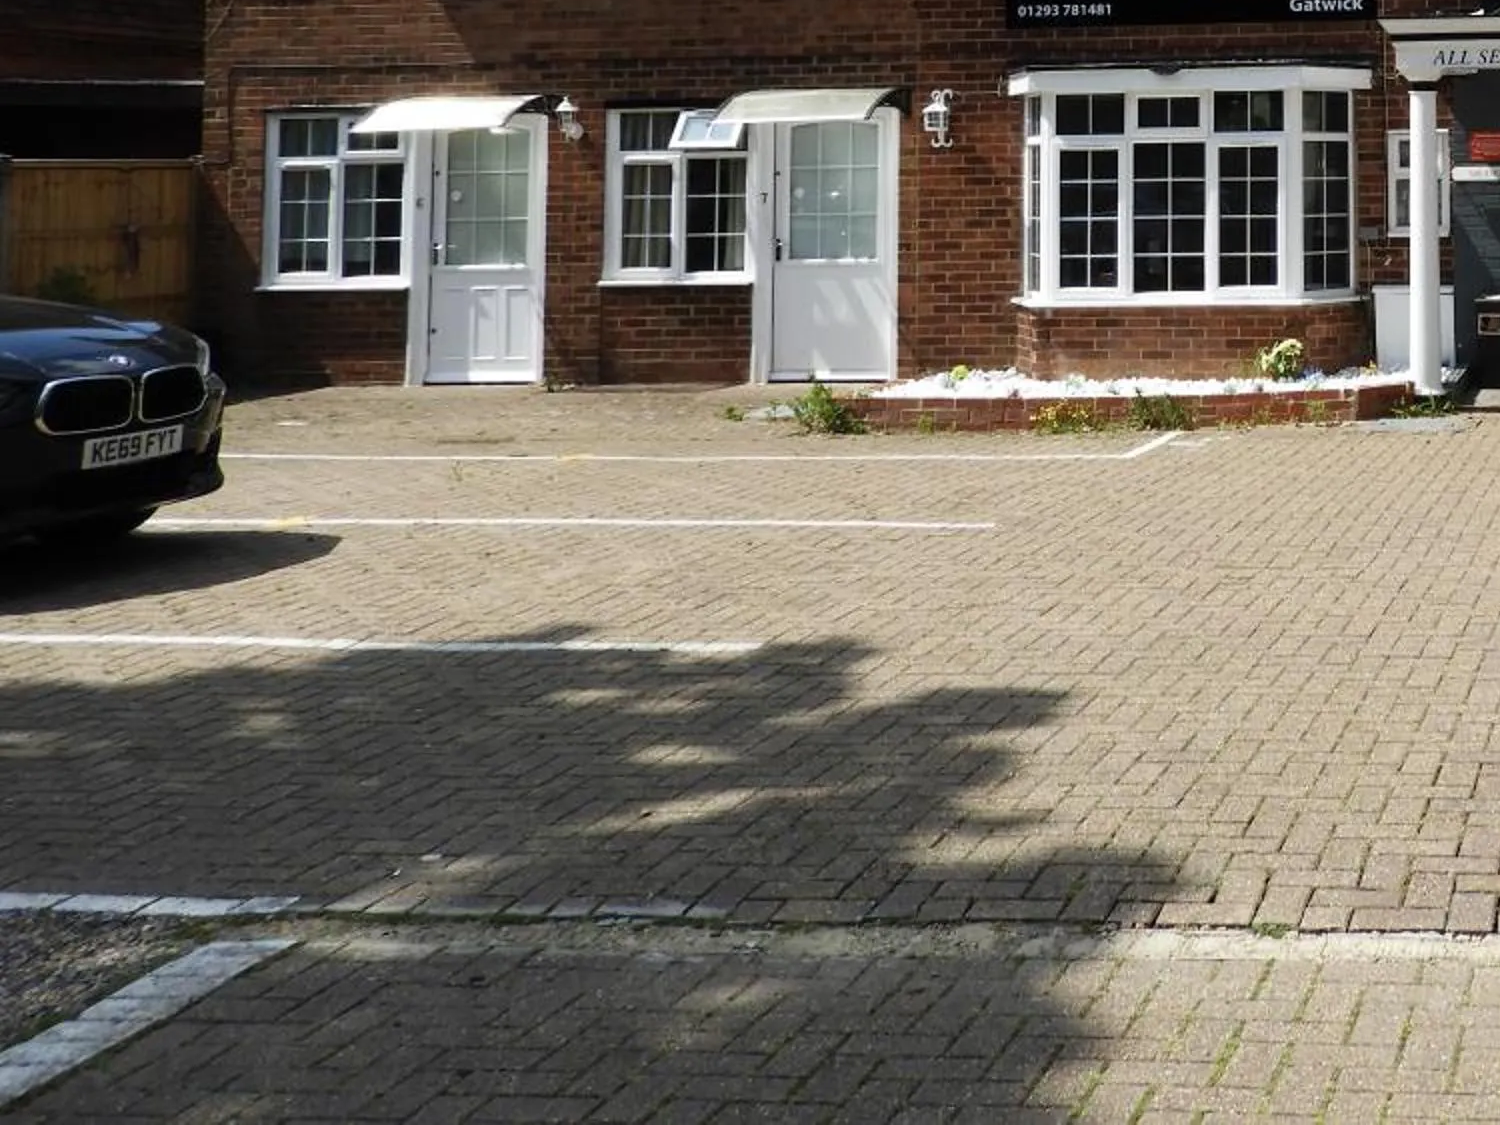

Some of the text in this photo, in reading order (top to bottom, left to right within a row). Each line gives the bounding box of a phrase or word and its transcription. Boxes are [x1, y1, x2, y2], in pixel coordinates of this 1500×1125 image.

[1017, 3, 1112, 18] 01293 781481
[1433, 49, 1472, 66] ALL
[92, 428, 177, 463] KE69 FYT
